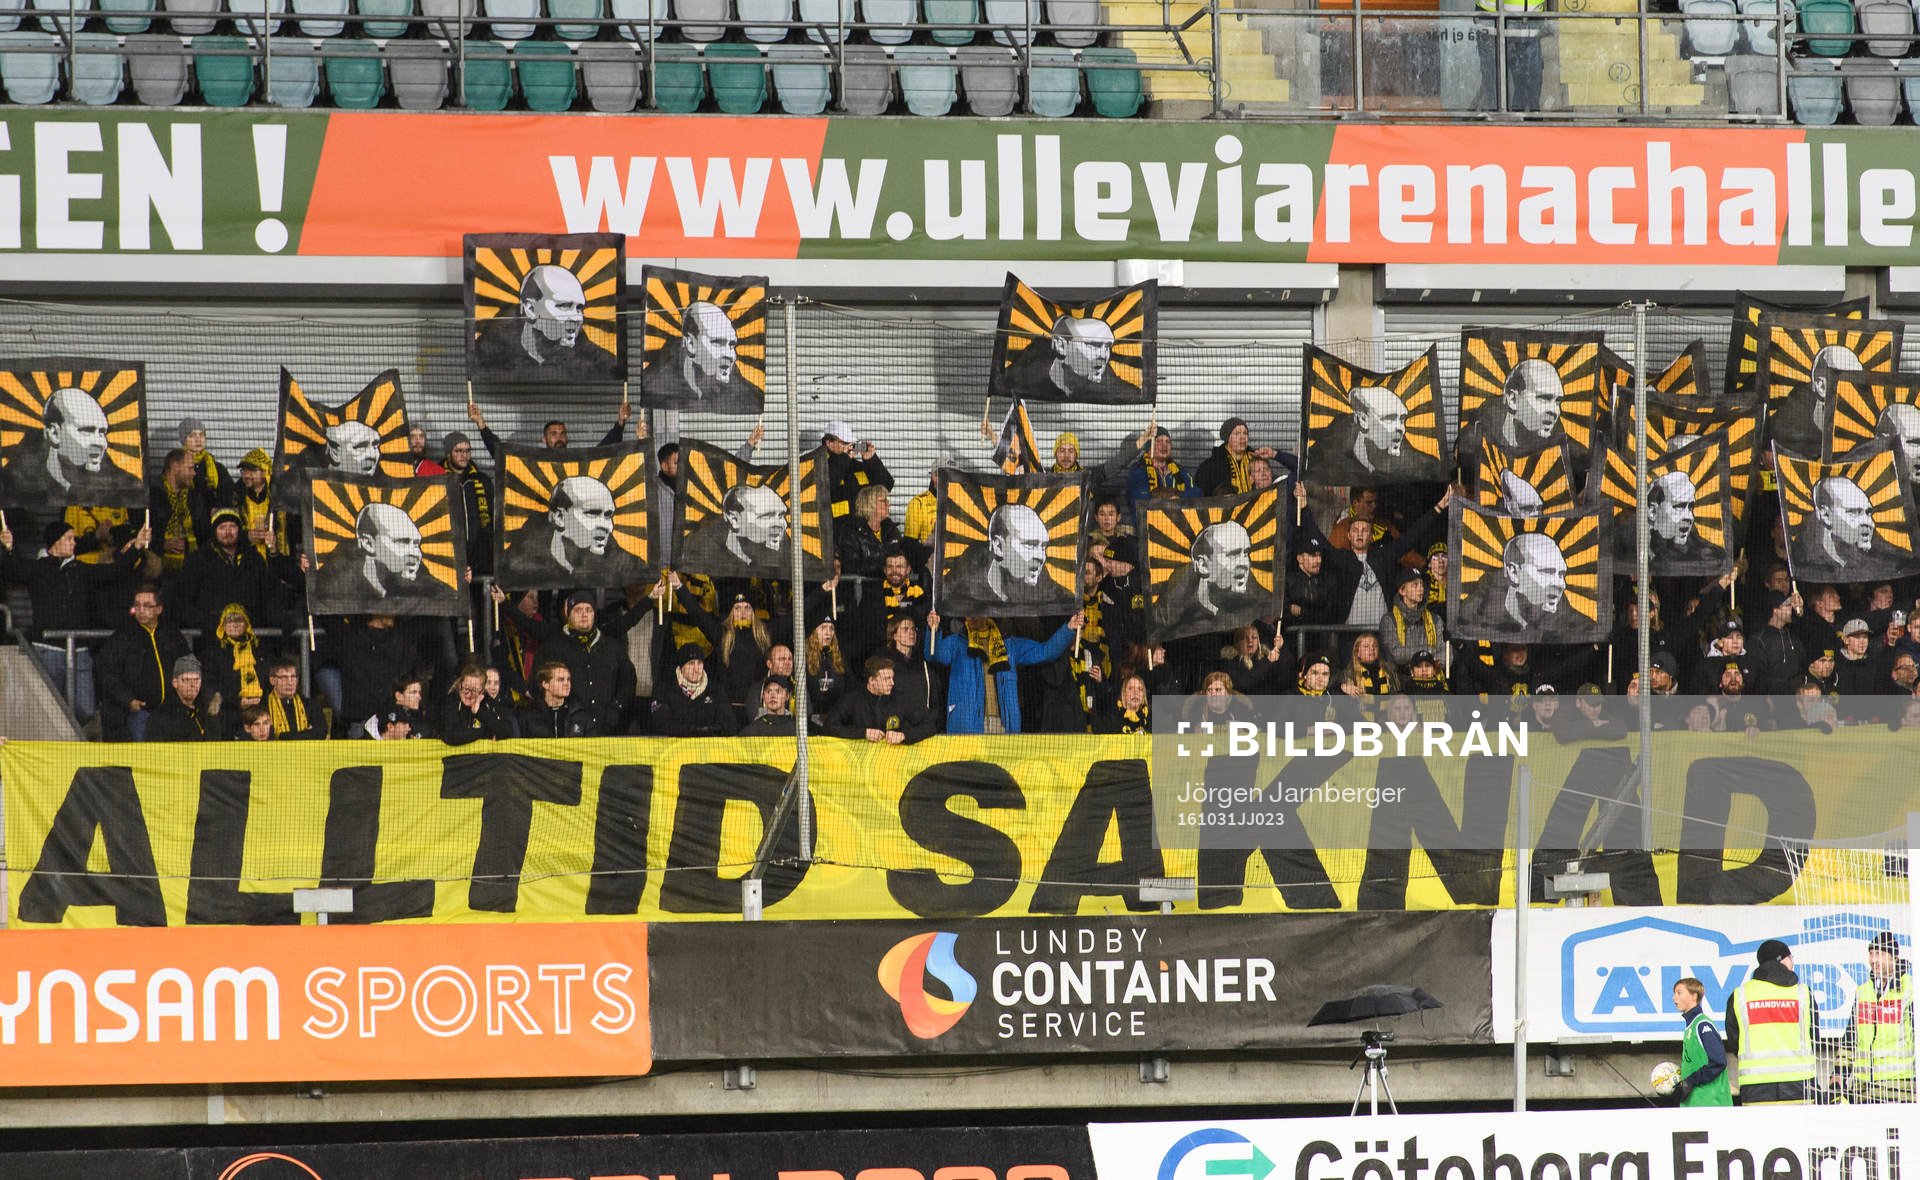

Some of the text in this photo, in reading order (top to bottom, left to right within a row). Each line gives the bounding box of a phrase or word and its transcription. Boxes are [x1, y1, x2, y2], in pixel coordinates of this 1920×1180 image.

[0, 121, 203, 251] EN
[548, 134, 1916, 248] www.ulleviarenachalle
[19, 747, 1817, 927] ALLTID SAKNAD
[996, 928, 1148, 955] LUNDBY
[303, 962, 637, 1039] SPORTS
[998, 1011, 1146, 1039] SERVICE
